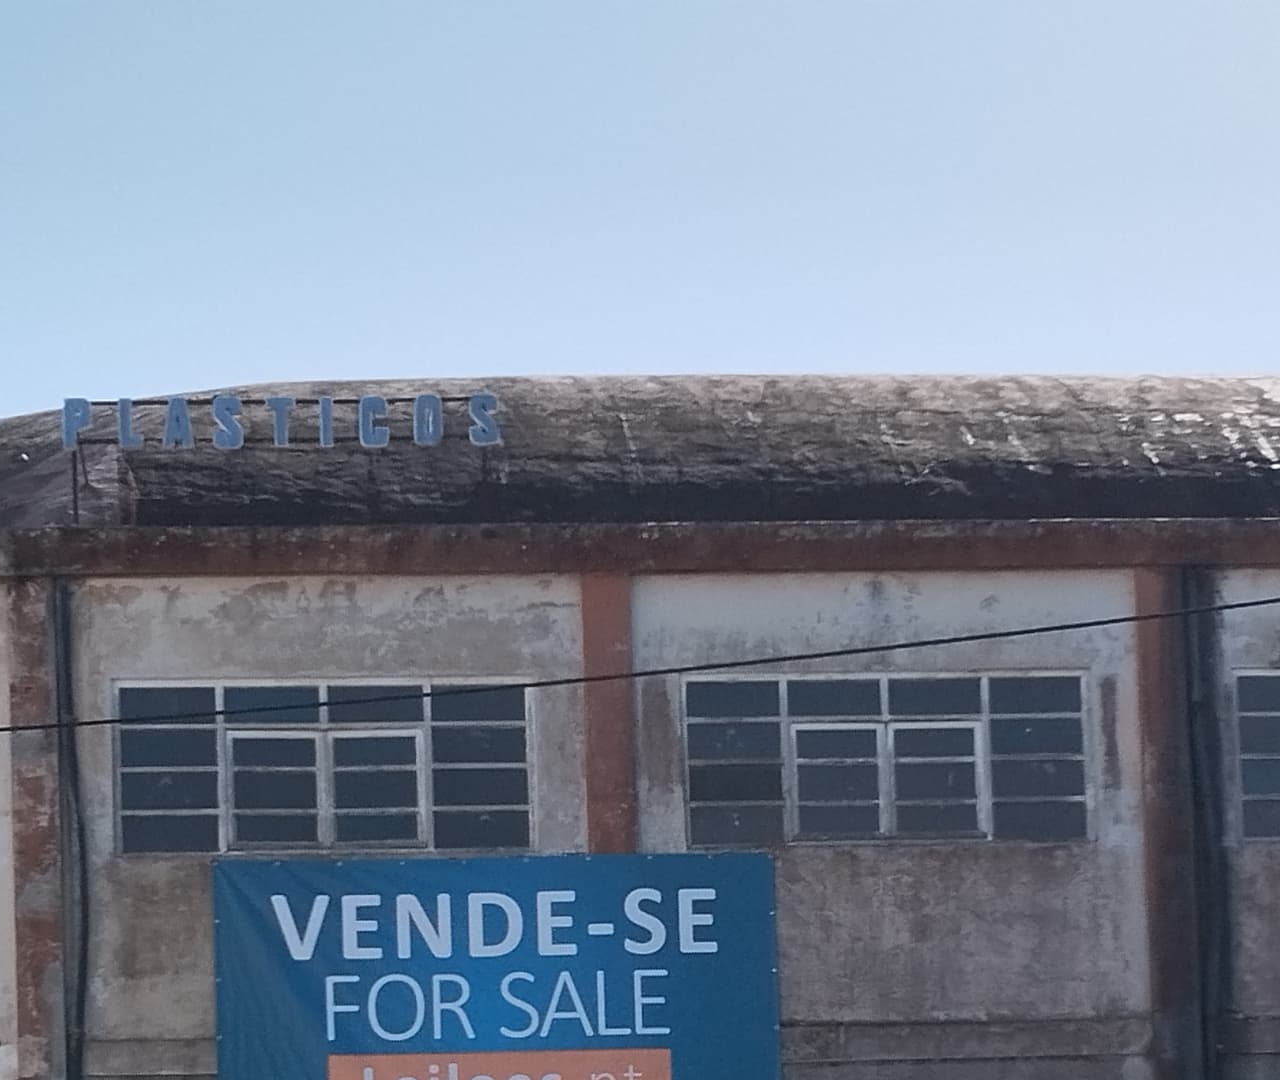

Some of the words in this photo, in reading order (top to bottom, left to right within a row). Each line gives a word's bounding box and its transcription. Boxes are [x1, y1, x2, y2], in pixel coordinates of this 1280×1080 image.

[62, 392, 503, 450] PLASTICOS
[270, 887, 719, 962] VENDE-SE
[325, 974, 475, 1042] FOR
[499, 968, 671, 1039] SALE
